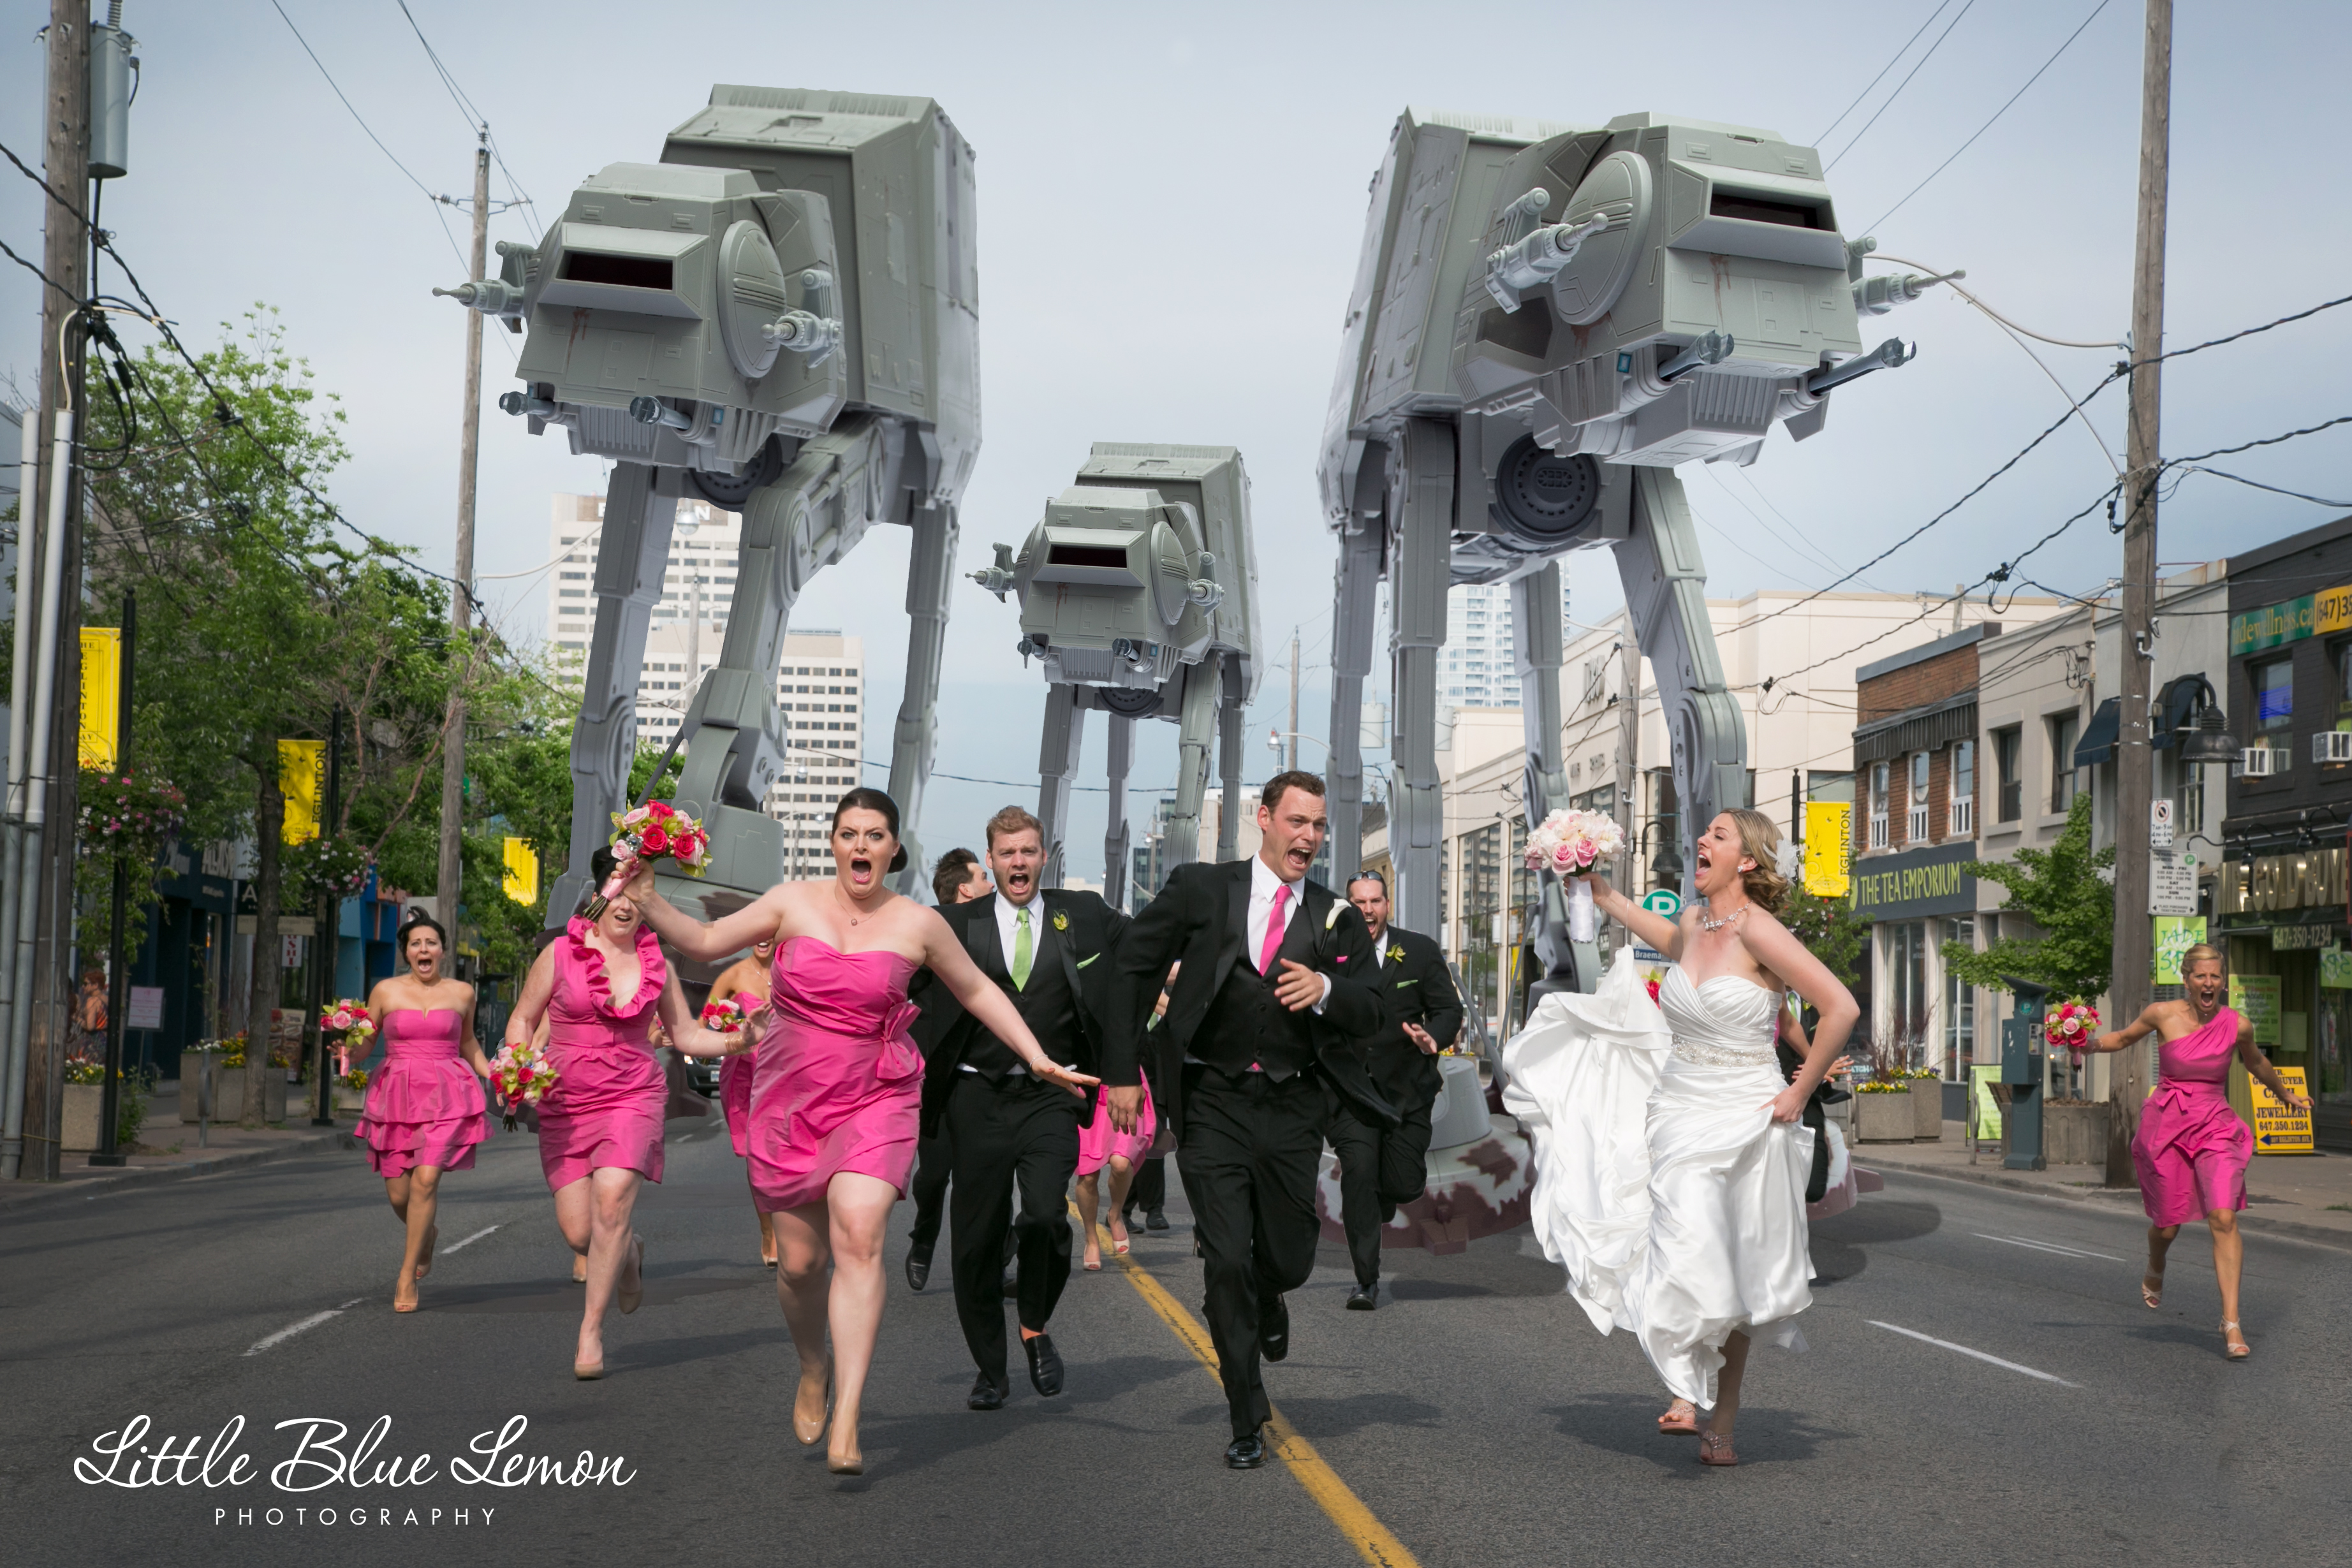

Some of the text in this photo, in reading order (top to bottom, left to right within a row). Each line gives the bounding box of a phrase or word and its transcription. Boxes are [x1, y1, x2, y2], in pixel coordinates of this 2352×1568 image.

[312, 748, 326, 823] EGLINTON
[1840, 809, 1851, 876] EGLINTON
[1860, 861, 1960, 905] THE TEA EMPORIUM
[1652, 896, 1676, 915] P
[2157, 929, 2205, 949] JADE
[2274, 925, 2332, 948] 647-350-1234
[1635, 950, 1663, 959] Braema
[2160, 950, 2185, 974] SP
[2256, 1107, 2308, 1118] JEWELLERY
[2259, 1121, 2309, 1131] 647.350.1234
